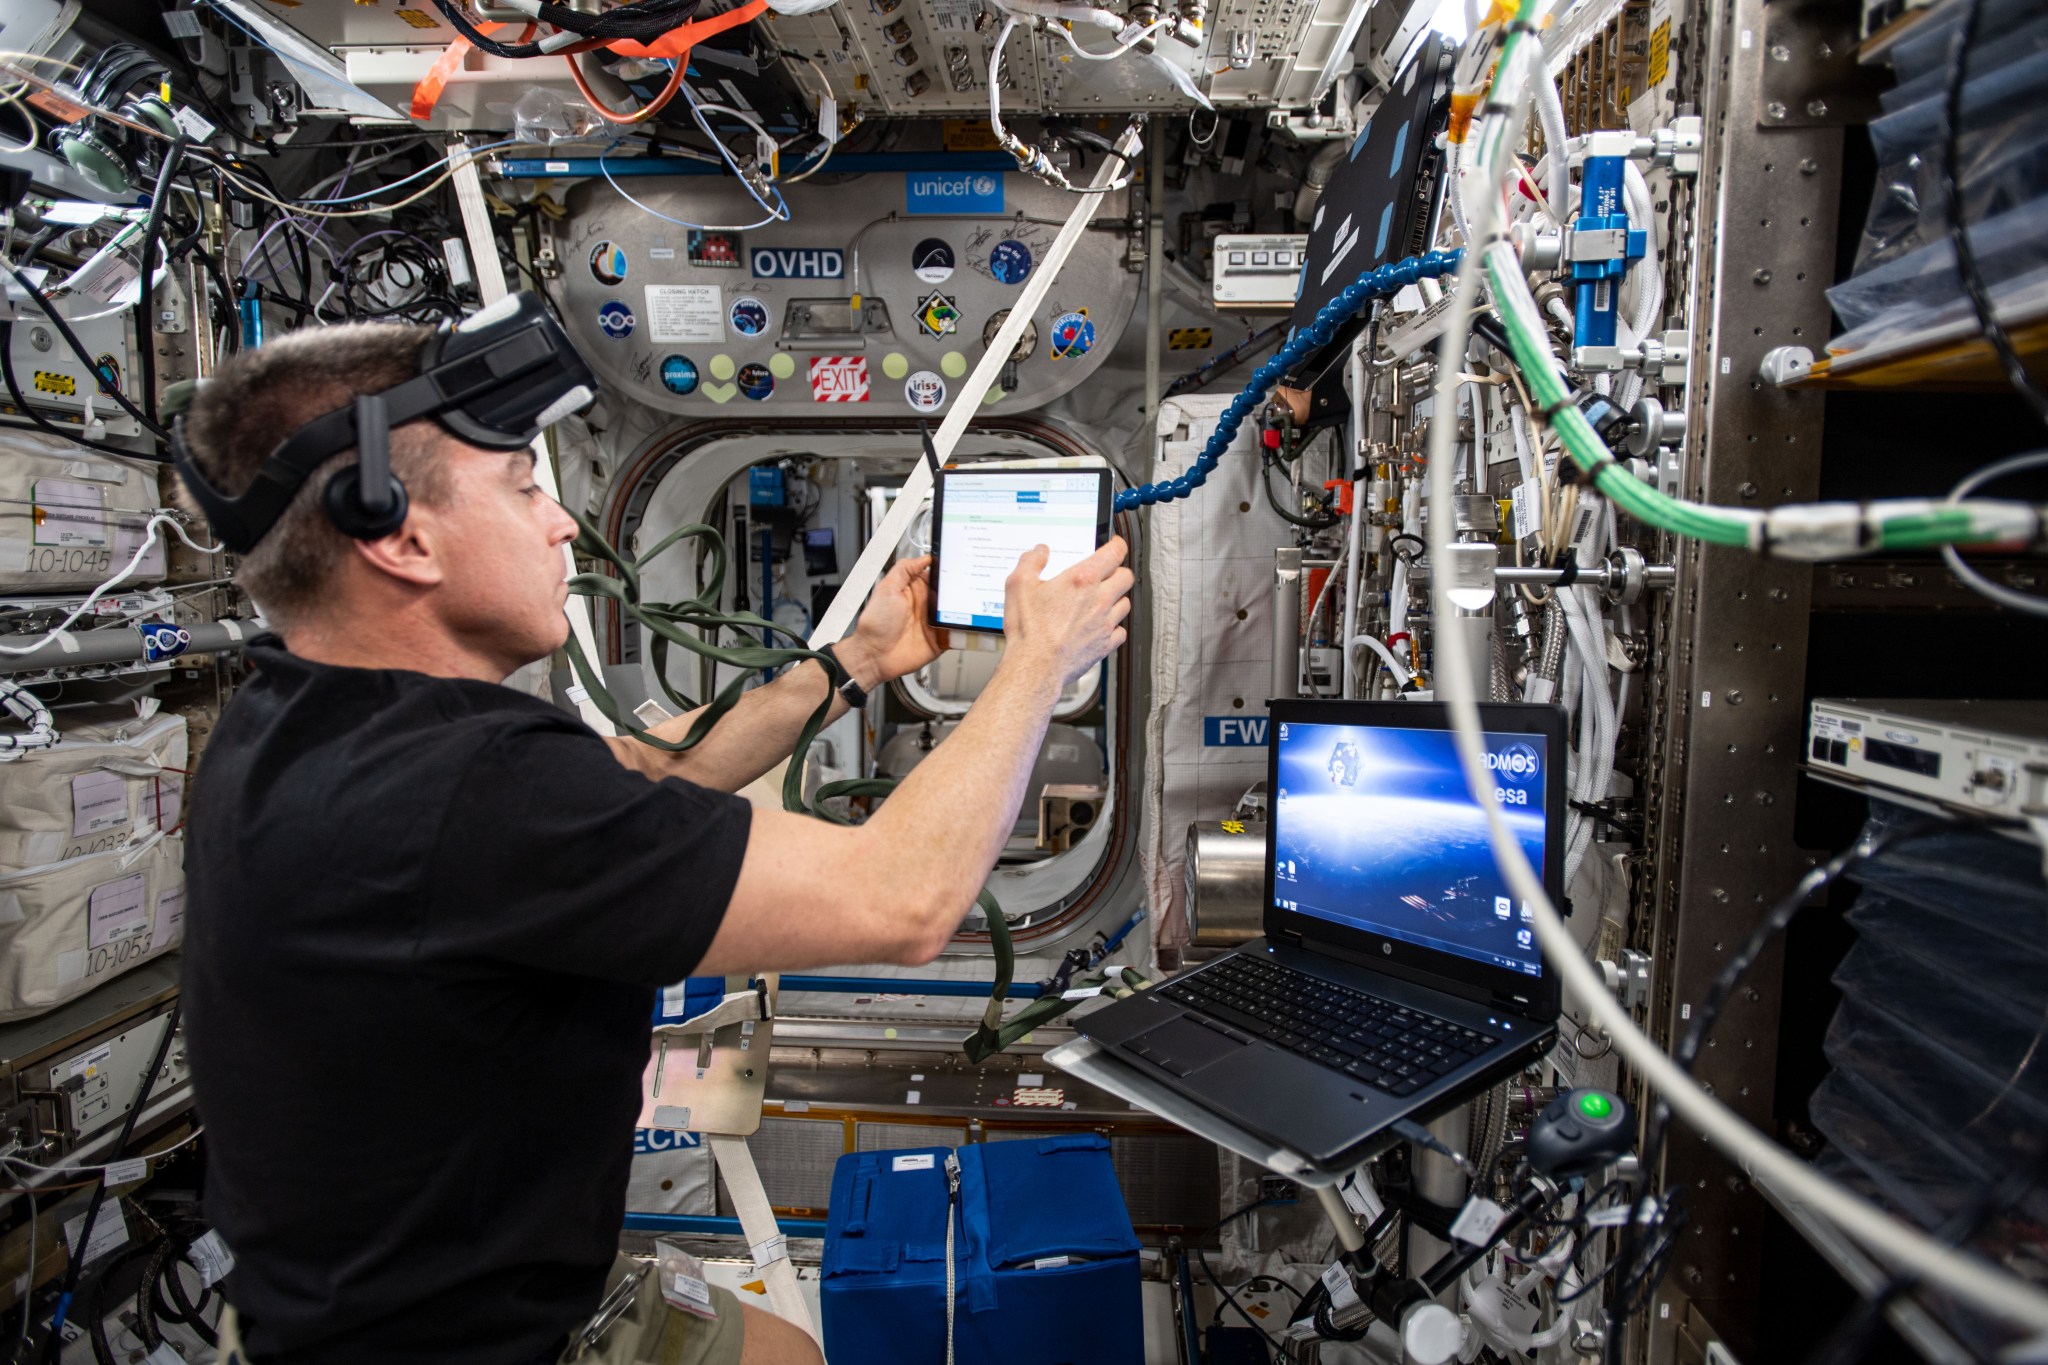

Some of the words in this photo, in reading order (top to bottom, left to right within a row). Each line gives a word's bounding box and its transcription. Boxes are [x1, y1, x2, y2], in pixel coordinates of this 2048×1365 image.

[914, 176, 972, 196] unicef
[754, 250, 842, 277] OVHD
[1054, 315, 1082, 334] principia
[820, 368, 858, 390] EXIT
[914, 380, 937, 390] iriss
[1220, 720, 1267, 744] FW
[1495, 787, 1527, 805] esa
[634, 1131, 697, 1151] ECK
